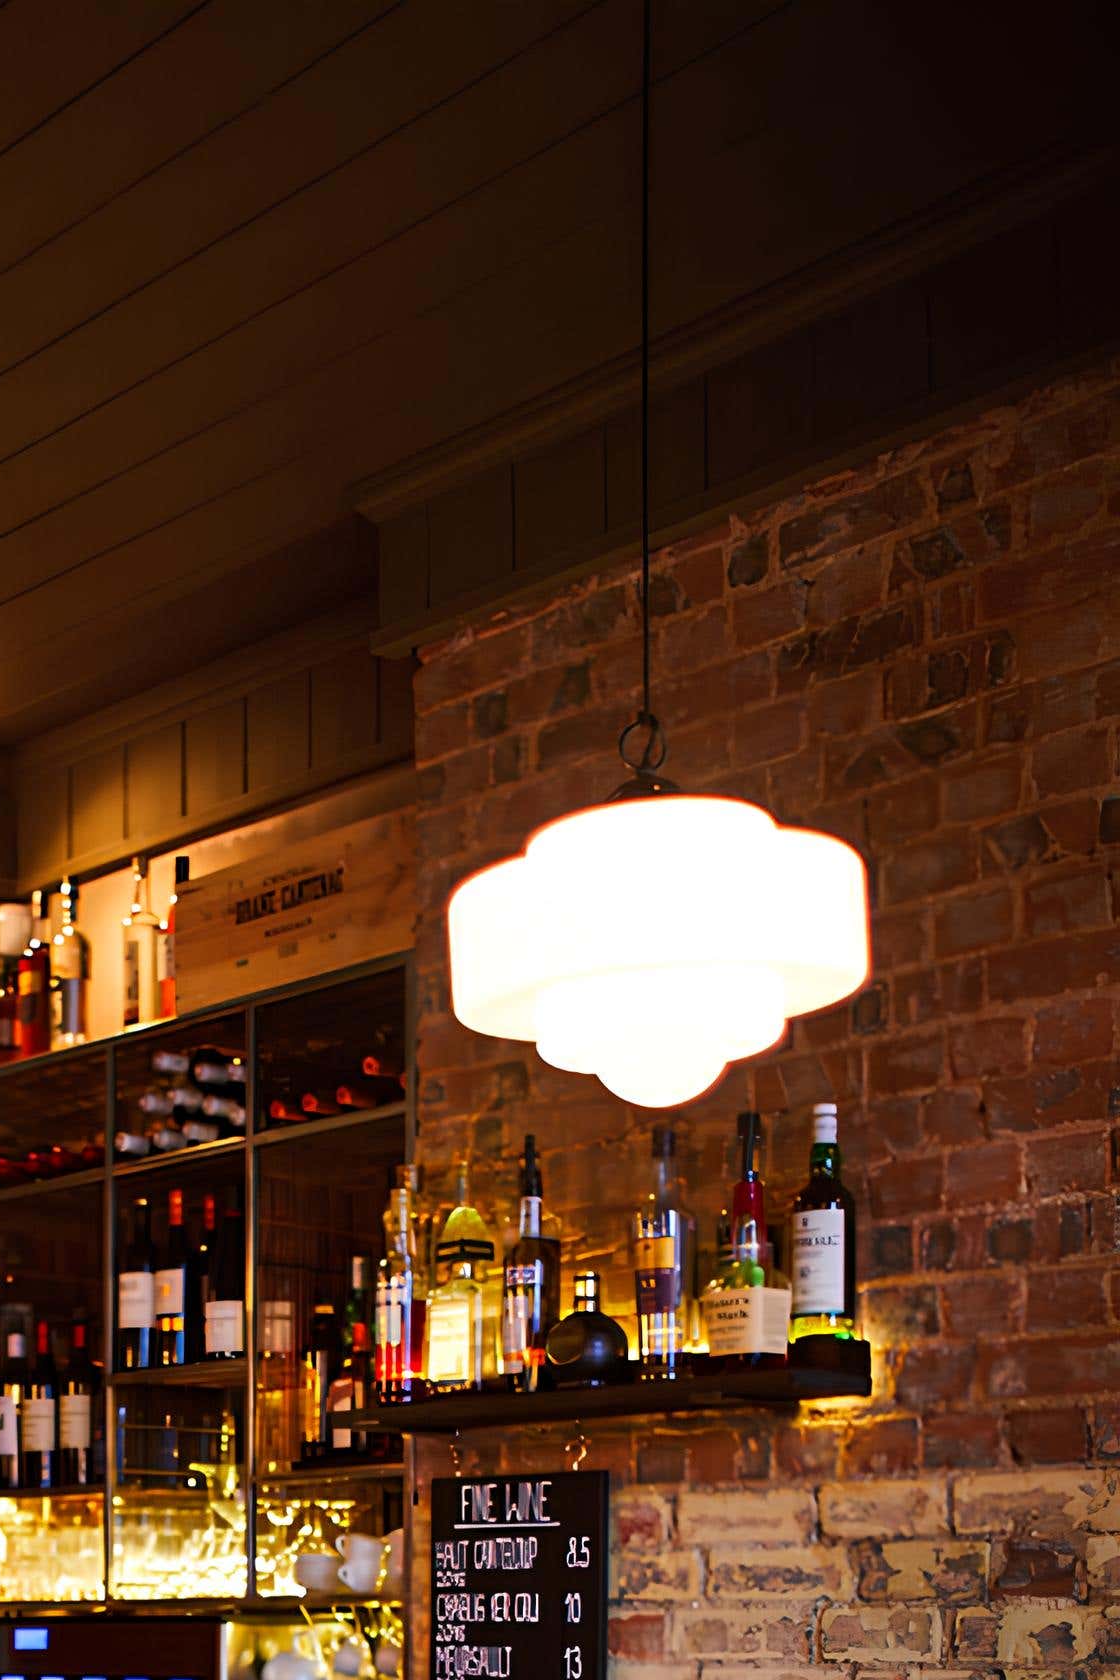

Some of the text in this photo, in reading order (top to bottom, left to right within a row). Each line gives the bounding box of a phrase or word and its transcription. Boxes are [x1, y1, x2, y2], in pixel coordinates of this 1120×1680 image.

[461, 1481, 552, 1522] FINE WINE
[564, 1592, 582, 1623] 10
[563, 1645, 582, 1679] 13
